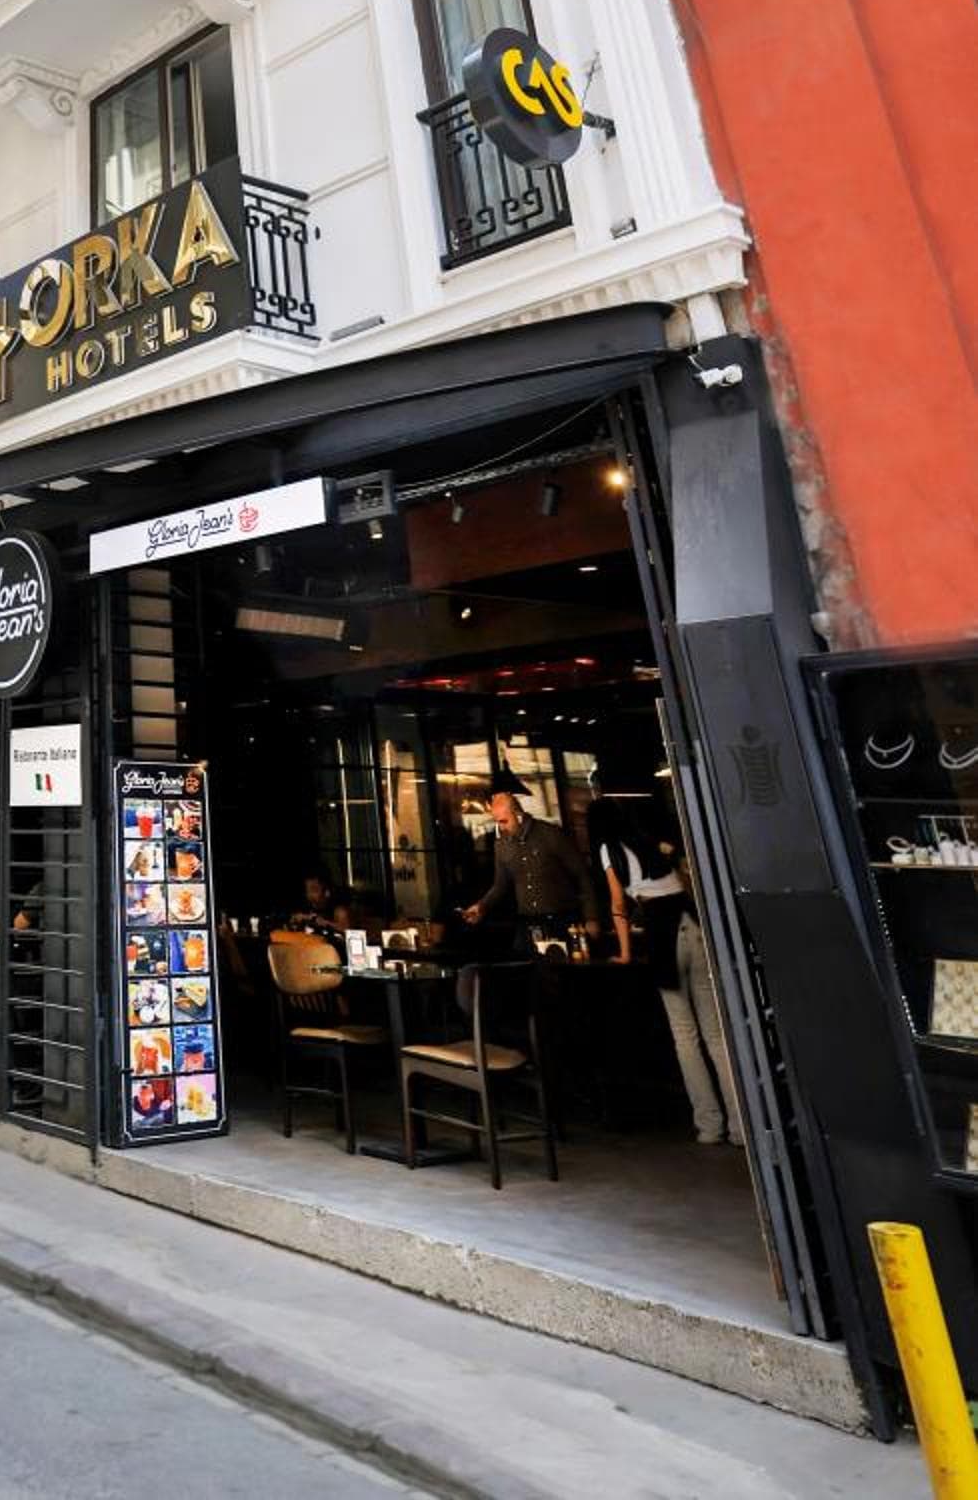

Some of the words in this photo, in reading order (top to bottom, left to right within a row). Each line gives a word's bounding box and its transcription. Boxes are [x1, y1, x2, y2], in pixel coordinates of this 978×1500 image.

[20, 180, 240, 348] ORKA
[46, 291, 219, 393] HOTELS
[145, 518, 190, 559] Gloria
[187, 508, 234, 549] Jean's
